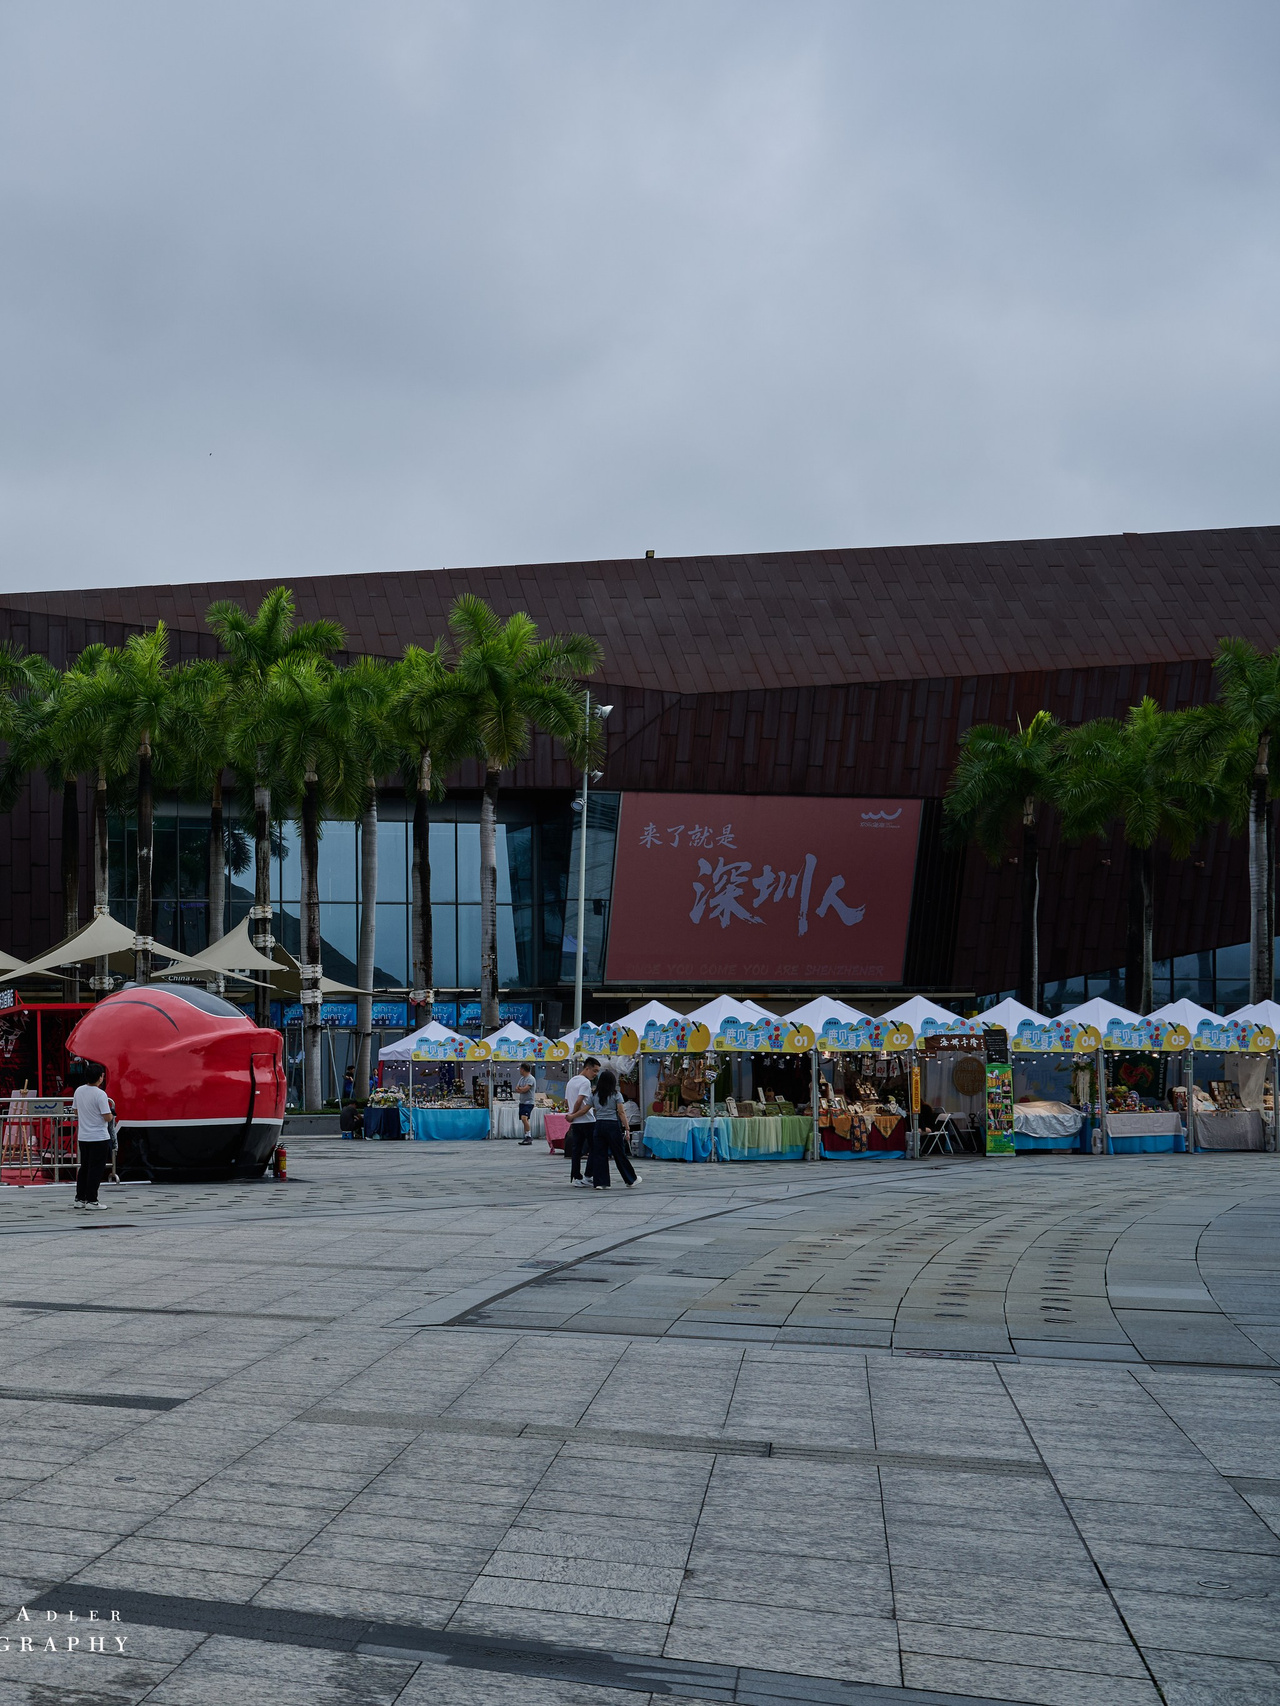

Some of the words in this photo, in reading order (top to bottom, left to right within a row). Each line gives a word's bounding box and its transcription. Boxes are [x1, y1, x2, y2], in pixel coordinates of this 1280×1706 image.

[638, 821, 738, 850] 来了就是
[689, 853, 866, 937] 深圳人
[793, 1035, 808, 1047] 01
[892, 1033, 908, 1045] 02
[1081, 1036, 1096, 1047] 04
[1171, 1035, 1185, 1045] 05
[1257, 1036, 1271, 1047] 06
[474, 1048, 486, 1057] 29
[552, 1048, 565, 1057] 30
